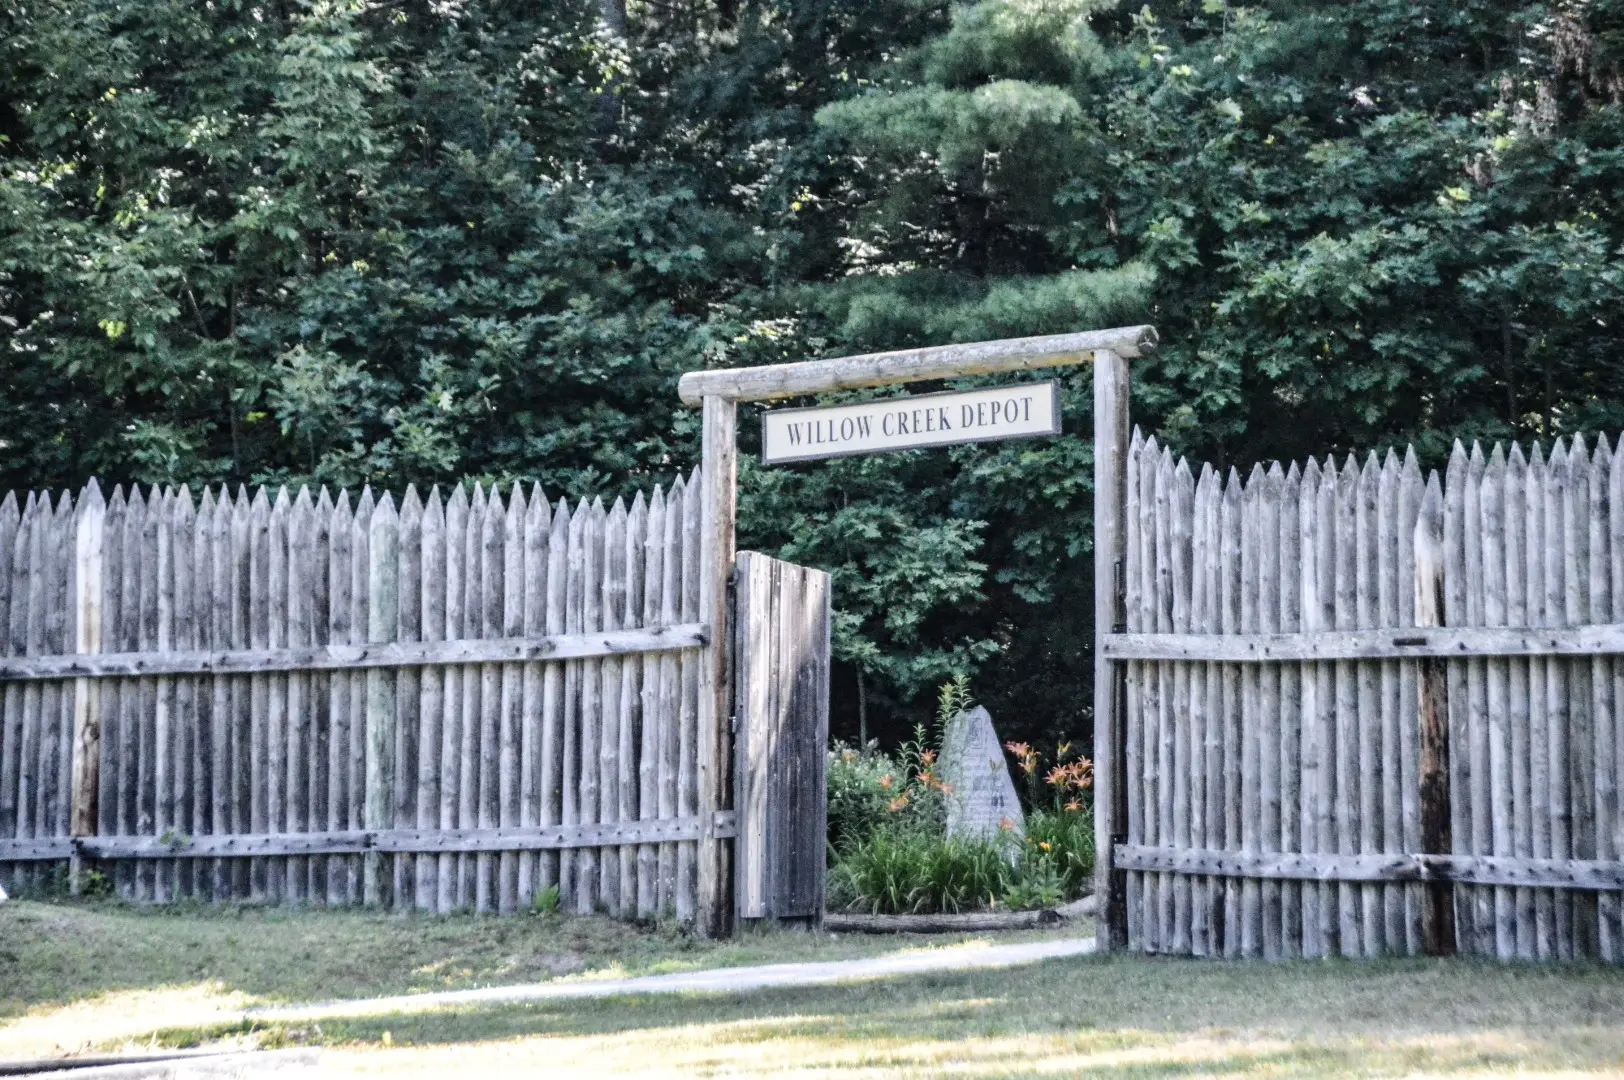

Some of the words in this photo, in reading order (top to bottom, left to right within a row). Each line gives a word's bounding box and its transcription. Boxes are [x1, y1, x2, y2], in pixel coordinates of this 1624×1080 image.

[787, 415, 873, 446] WILLOW
[882, 407, 952, 437] CREEK
[961, 397, 1033, 428] DEPOT
